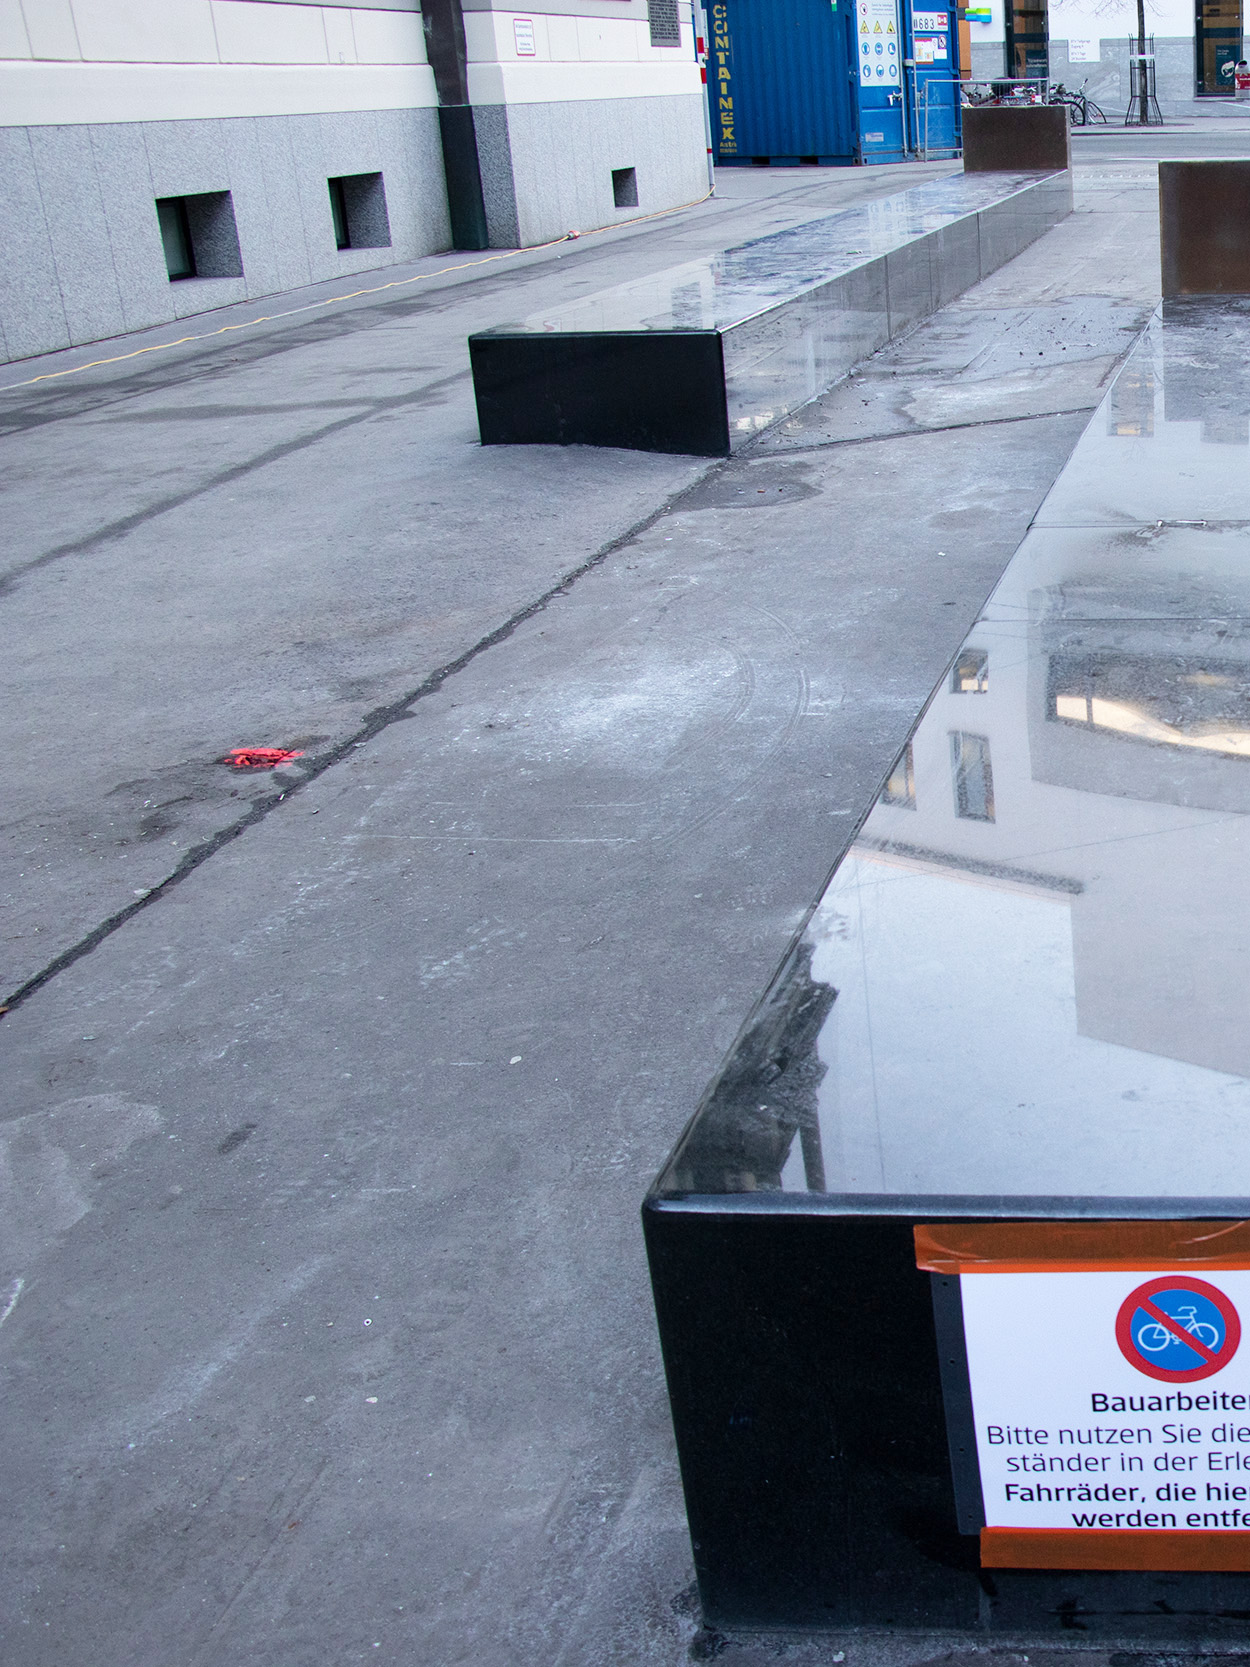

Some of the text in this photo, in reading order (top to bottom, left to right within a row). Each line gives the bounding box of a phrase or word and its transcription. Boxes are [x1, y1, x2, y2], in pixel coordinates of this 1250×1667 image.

[712, 4, 735, 140] CONTAINEX
[987, 1425, 1049, 1445] Bitte
[1058, 1425, 1152, 1444] nutzen
[1161, 1423, 1202, 1443] Sie
[1006, 1452, 1112, 1472] ständer
[1120, 1452, 1144, 1471] in
[1153, 1452, 1199, 1471] der
[1004, 1483, 1146, 1503] Fahrräder,
[1155, 1483, 1197, 1501] die
[1071, 1509, 1177, 1527] werden
